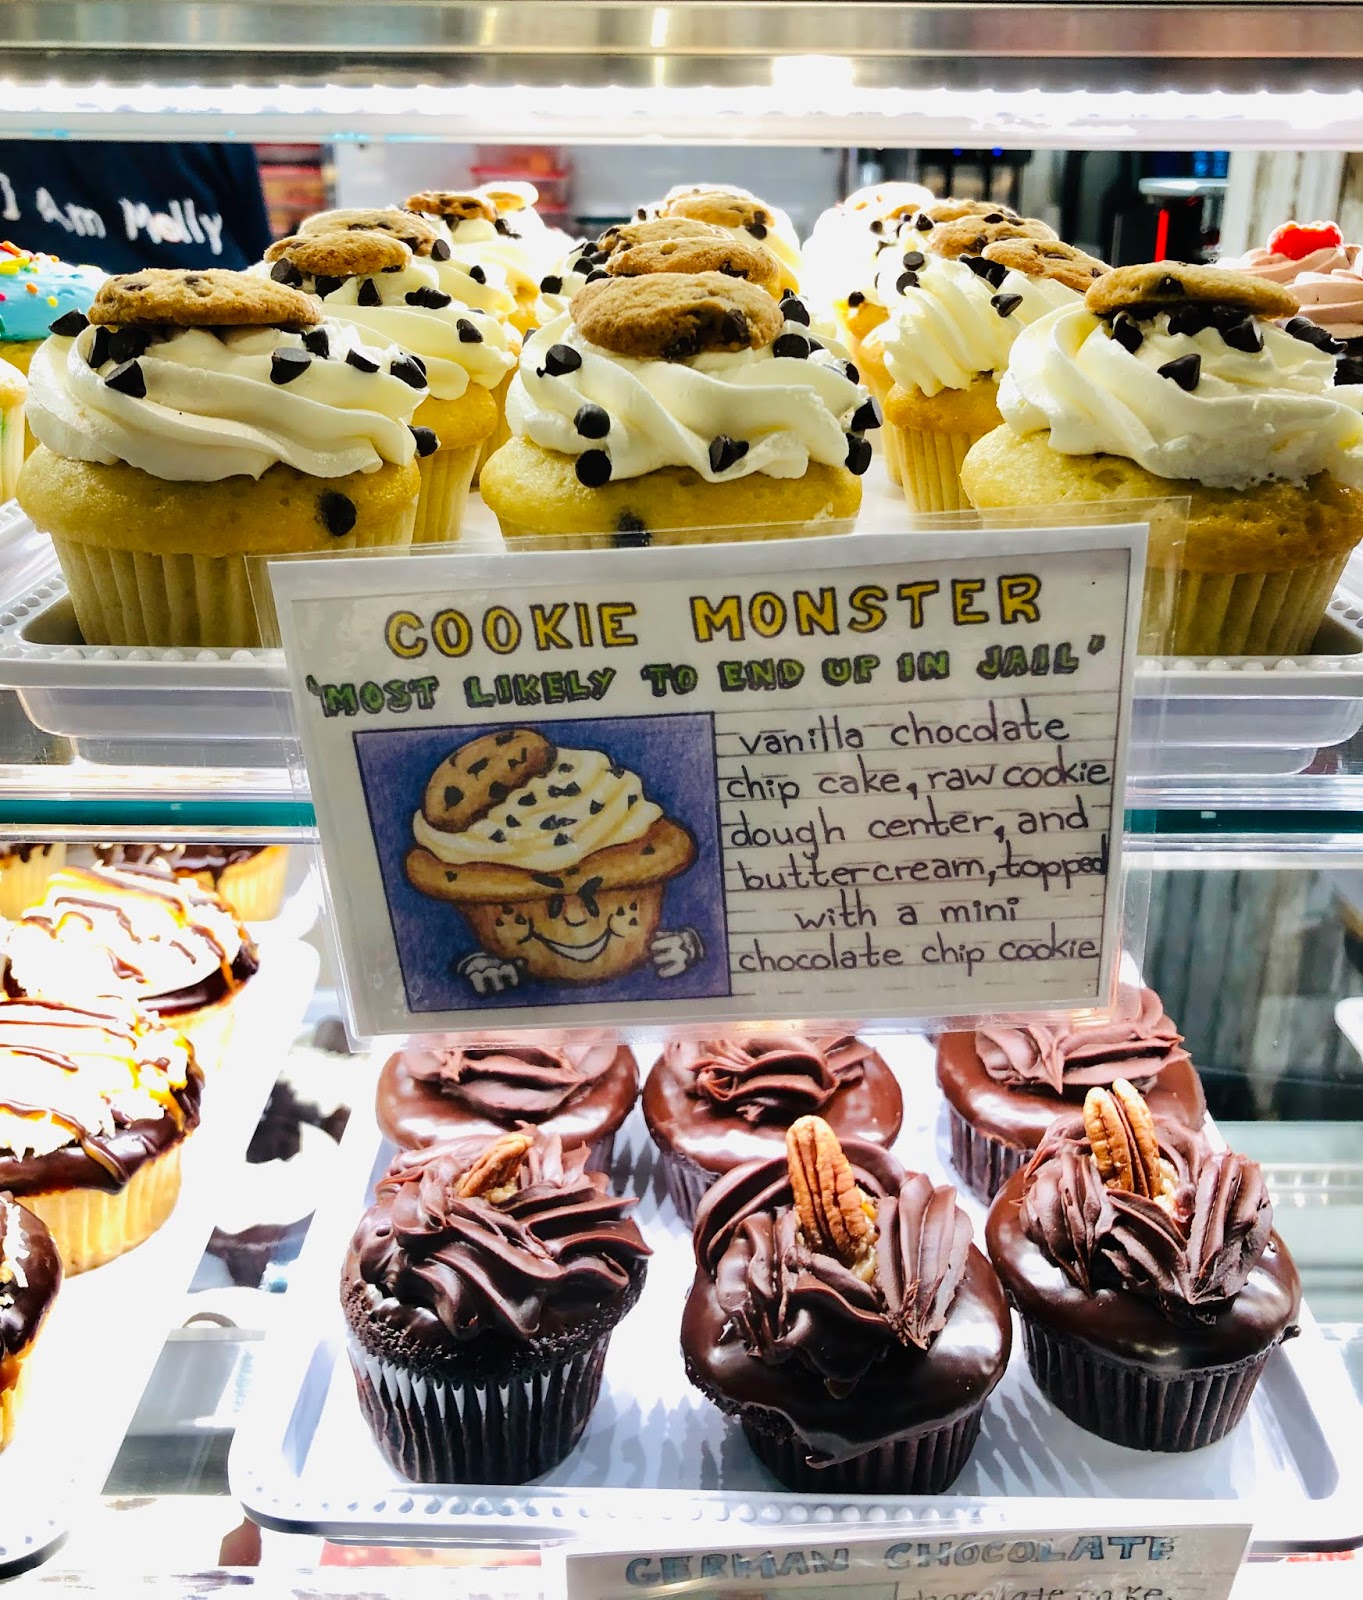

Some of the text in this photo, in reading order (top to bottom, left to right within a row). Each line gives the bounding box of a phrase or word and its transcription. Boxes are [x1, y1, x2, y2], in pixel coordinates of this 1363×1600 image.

[36, 187, 107, 239] Am
[118, 197, 223, 256] Molly
[385, 573, 1041, 659] COOKIE MONSTER
[463, 667, 617, 709] LIKELY
[640, 663, 698, 698] TO
[717, 655, 805, 692] END
[821, 654, 880, 687] UP
[897, 650, 950, 681] IN
[739, 698, 1070, 755] vanilla chocolate
[727, 744, 1111, 808] chip cake, raw cookie
[730, 794, 1089, 860] dough center, and
[996, 833, 1107, 892] topped
[795, 888, 1019, 930] with a mini
[738, 921, 1099, 977] chocolate chip cookie
[624, 1535, 1176, 1586] GERMAN CHOCOLATE
